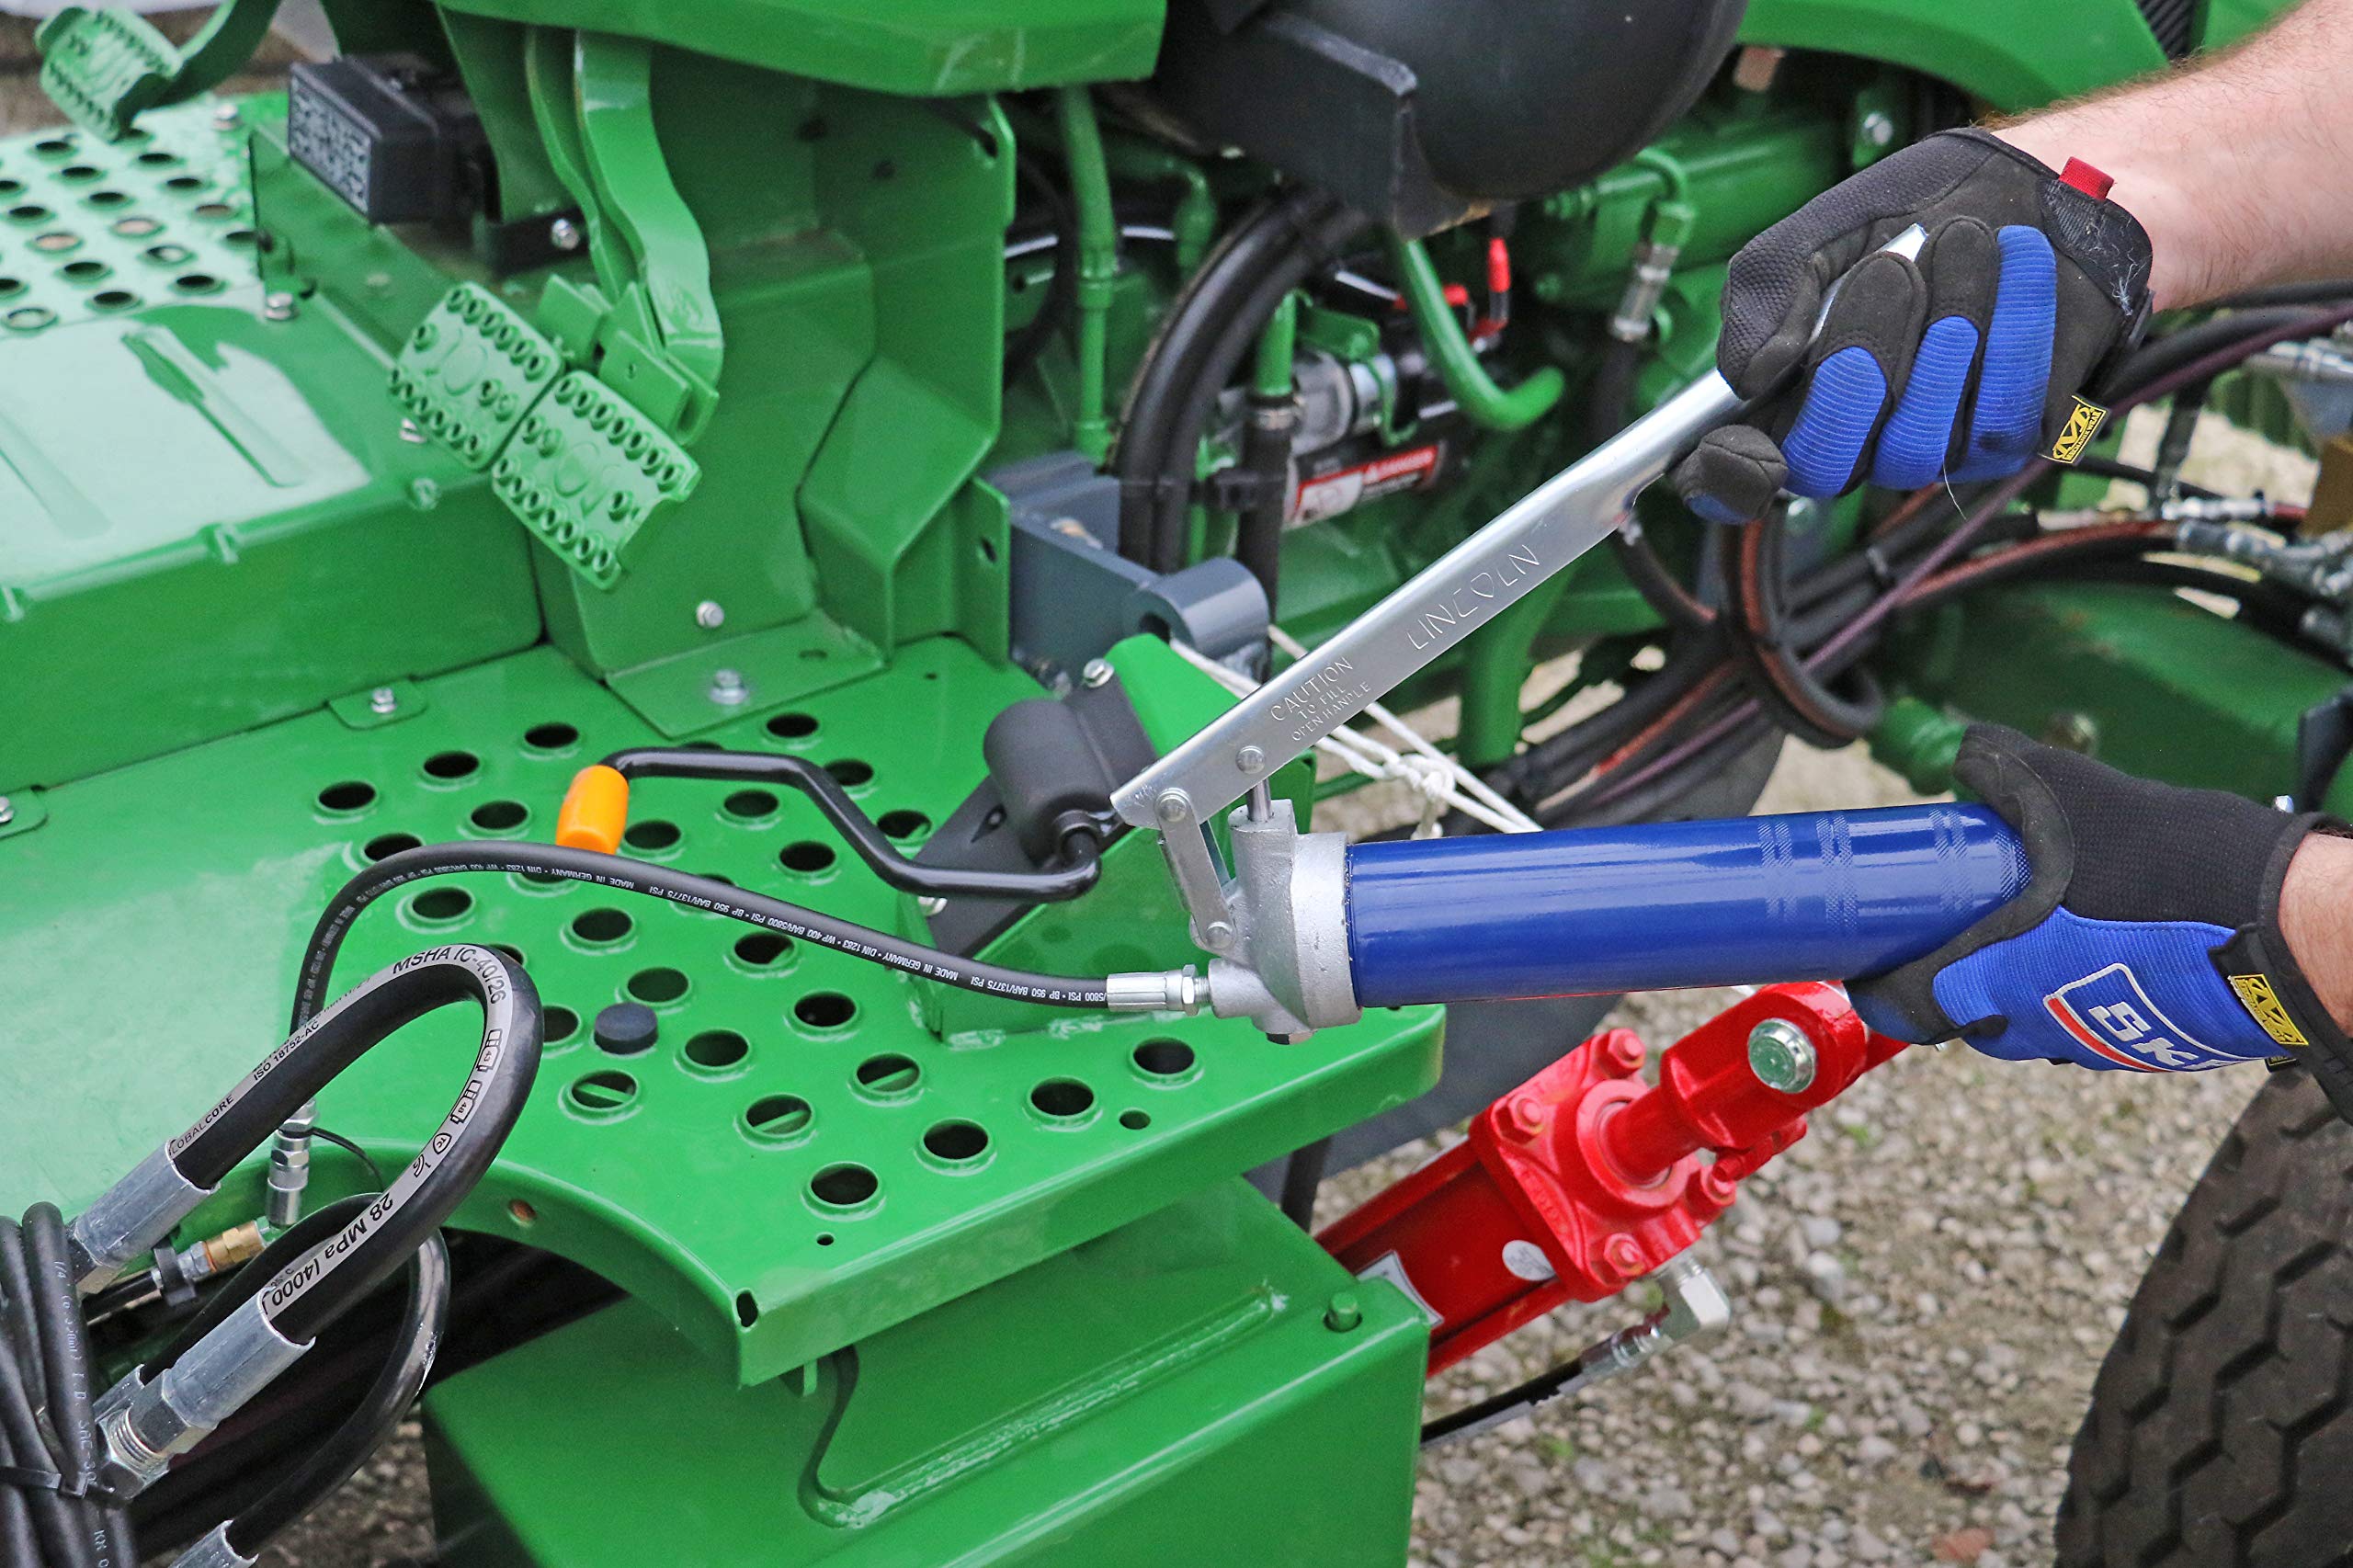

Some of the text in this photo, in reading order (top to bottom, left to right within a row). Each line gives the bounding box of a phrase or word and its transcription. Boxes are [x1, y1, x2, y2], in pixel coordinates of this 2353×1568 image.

[1405, 543, 1540, 651] LINCOLN
[1270, 656, 1354, 722] CAUTION
[1297, 685, 1347, 720] TO FILL
[551, 868, 593, 881] GERMANY
[596, 874, 607, 883] IN
[608, 876, 635, 890] MADE
[649, 885, 959, 981] MADE IN GERMANY DIN 1283 WP 400 BAR/5800 PSI BP 950 BAR/13775 PSI
[392, 947, 506, 1005] MSHA IC-40/26
[970, 975, 984, 987] PSI
[986, 980, 1029, 996] BAR/13775
[1031, 987, 1046, 998] 950
[1049, 991, 1061, 1000] BP
[1068, 991, 1081, 1002] PSI
[253, 1062, 271, 1081] ISO
[275, 1020, 321, 1066] 18752-AC
[369, 1192, 393, 1221] 28
[324, 1218, 368, 1260] MPa
